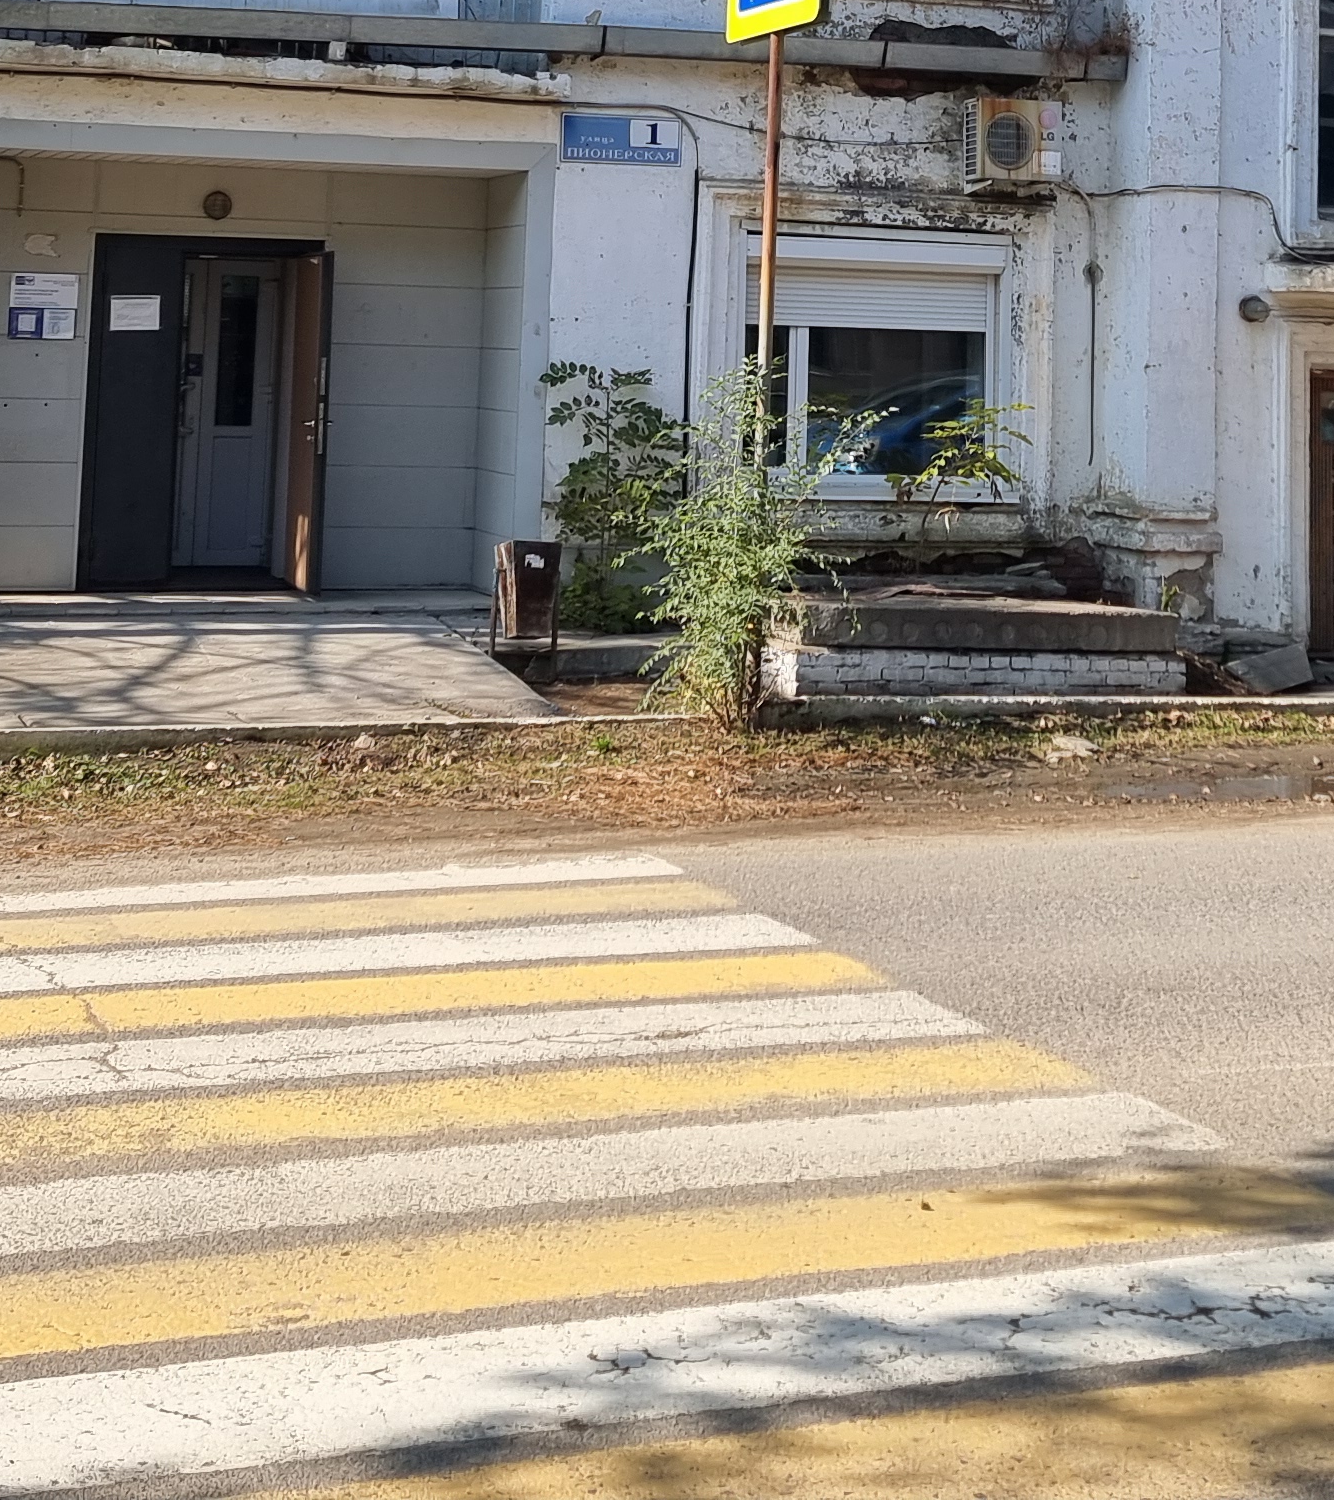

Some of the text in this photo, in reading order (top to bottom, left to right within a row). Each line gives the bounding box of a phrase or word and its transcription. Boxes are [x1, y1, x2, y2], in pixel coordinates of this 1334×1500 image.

[580, 135, 615, 145] улица
[645, 122, 662, 146] 1
[1040, 131, 1055, 141] LG
[566, 147, 675, 162] ПИОНЕРСКАЯ
